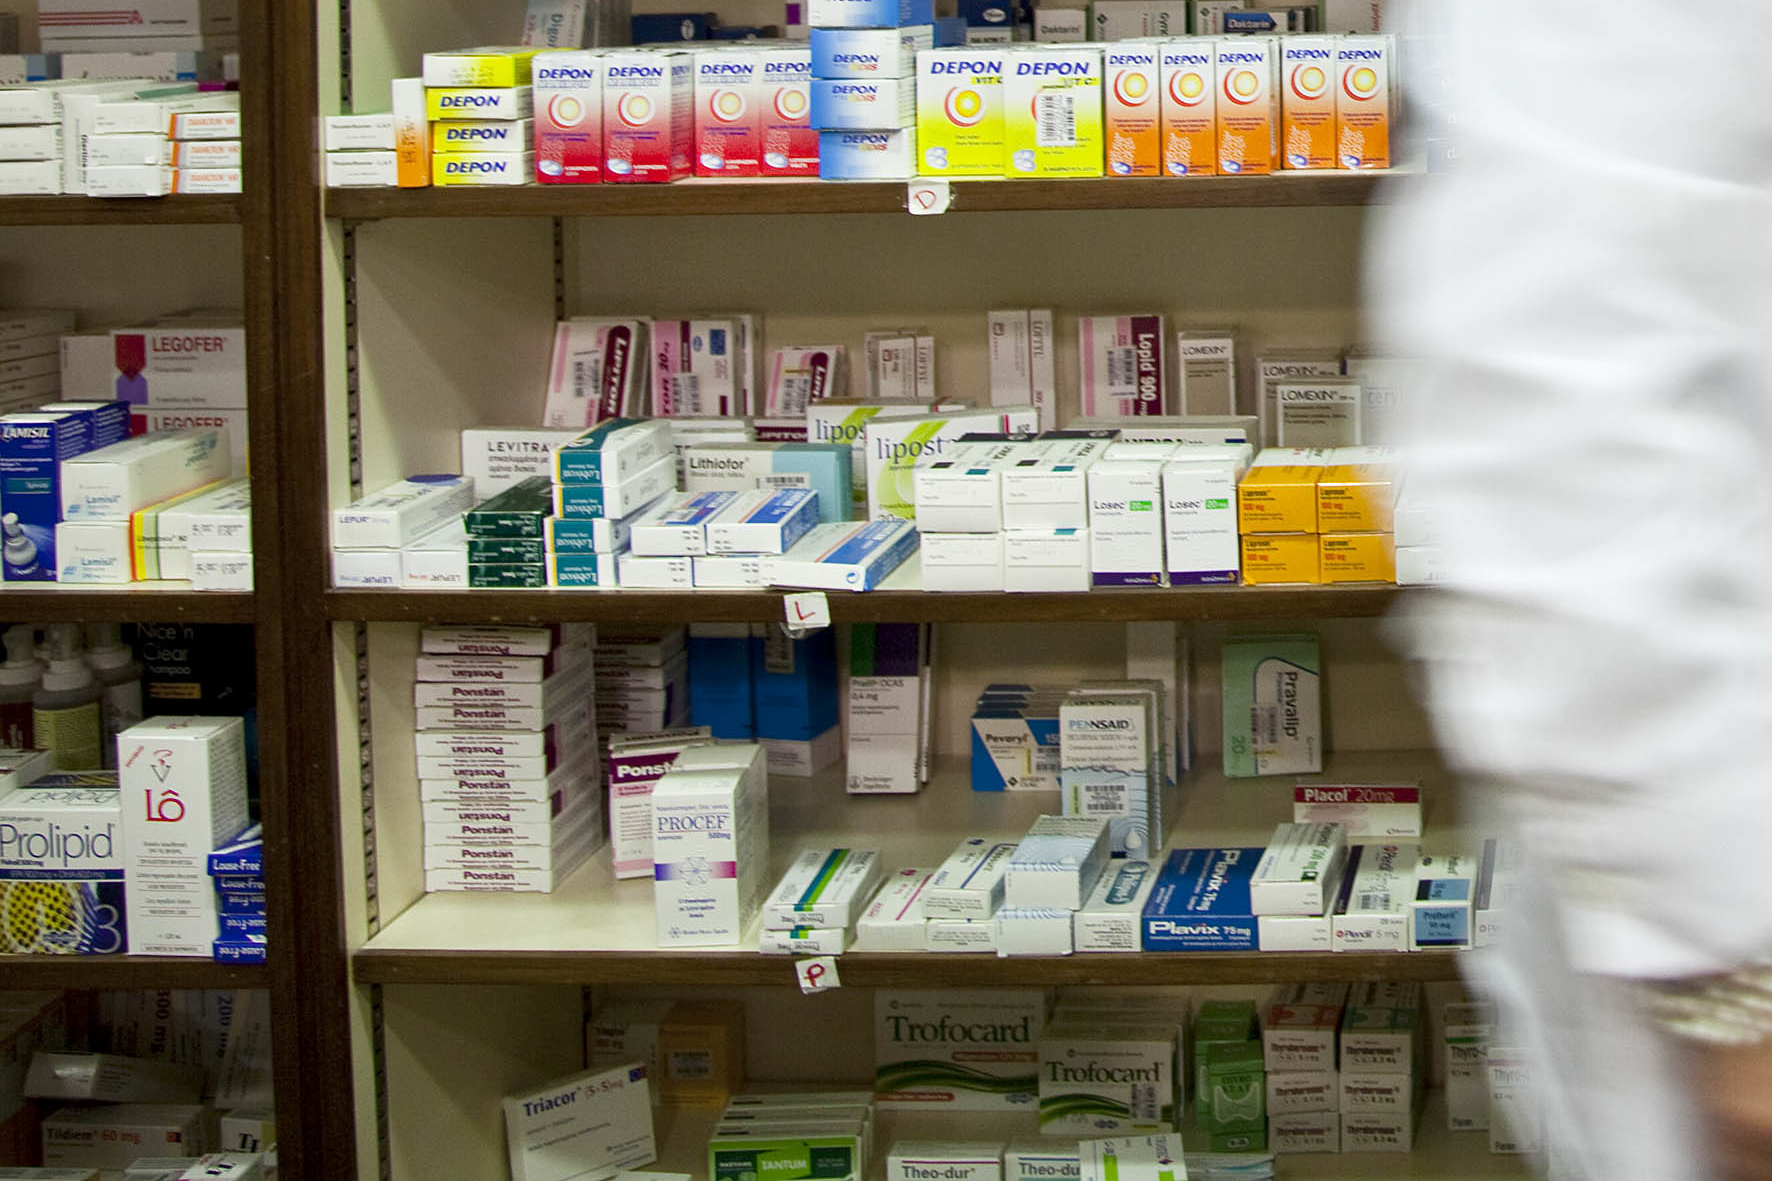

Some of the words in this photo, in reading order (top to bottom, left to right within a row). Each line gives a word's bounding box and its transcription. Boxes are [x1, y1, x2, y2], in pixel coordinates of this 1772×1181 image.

[538, 68, 592, 80] DEPON
[608, 67, 663, 78] DEPON
[441, 96, 499, 107] DEPON
[447, 129, 507, 140] DEPON
[446, 162, 506, 173] DEPON
[152, 337, 223, 352] LEGOFER
[488, 442, 548, 453] LEVITRA
[690, 456, 744, 469] Lithiofor
[1169, 500, 1201, 509] Losec
[452, 688, 504, 697] Ponstan
[1282, 672, 1298, 737] Pravalip
[454, 710, 506, 718] Ponstan
[459, 781, 510, 790] Ponstan
[1304, 789, 1348, 802] Placol
[145, 790, 185, 822] Lô
[462, 826, 514, 834] Ponstan
[658, 817, 729, 831] PROCEF
[0, 824, 113, 866] Prolipid
[462, 850, 514, 858] Ponstan
[463, 871, 515, 880] Ponstan
[94, 905, 121, 953] 3
[1149, 921, 1220, 936] Plavix
[886, 1015, 1030, 1043] Trofocard
[1046, 1061, 1159, 1083] Trofocard
[523, 1090, 577, 1117] Triacor
[902, 1166, 969, 1179] Theo-dur
